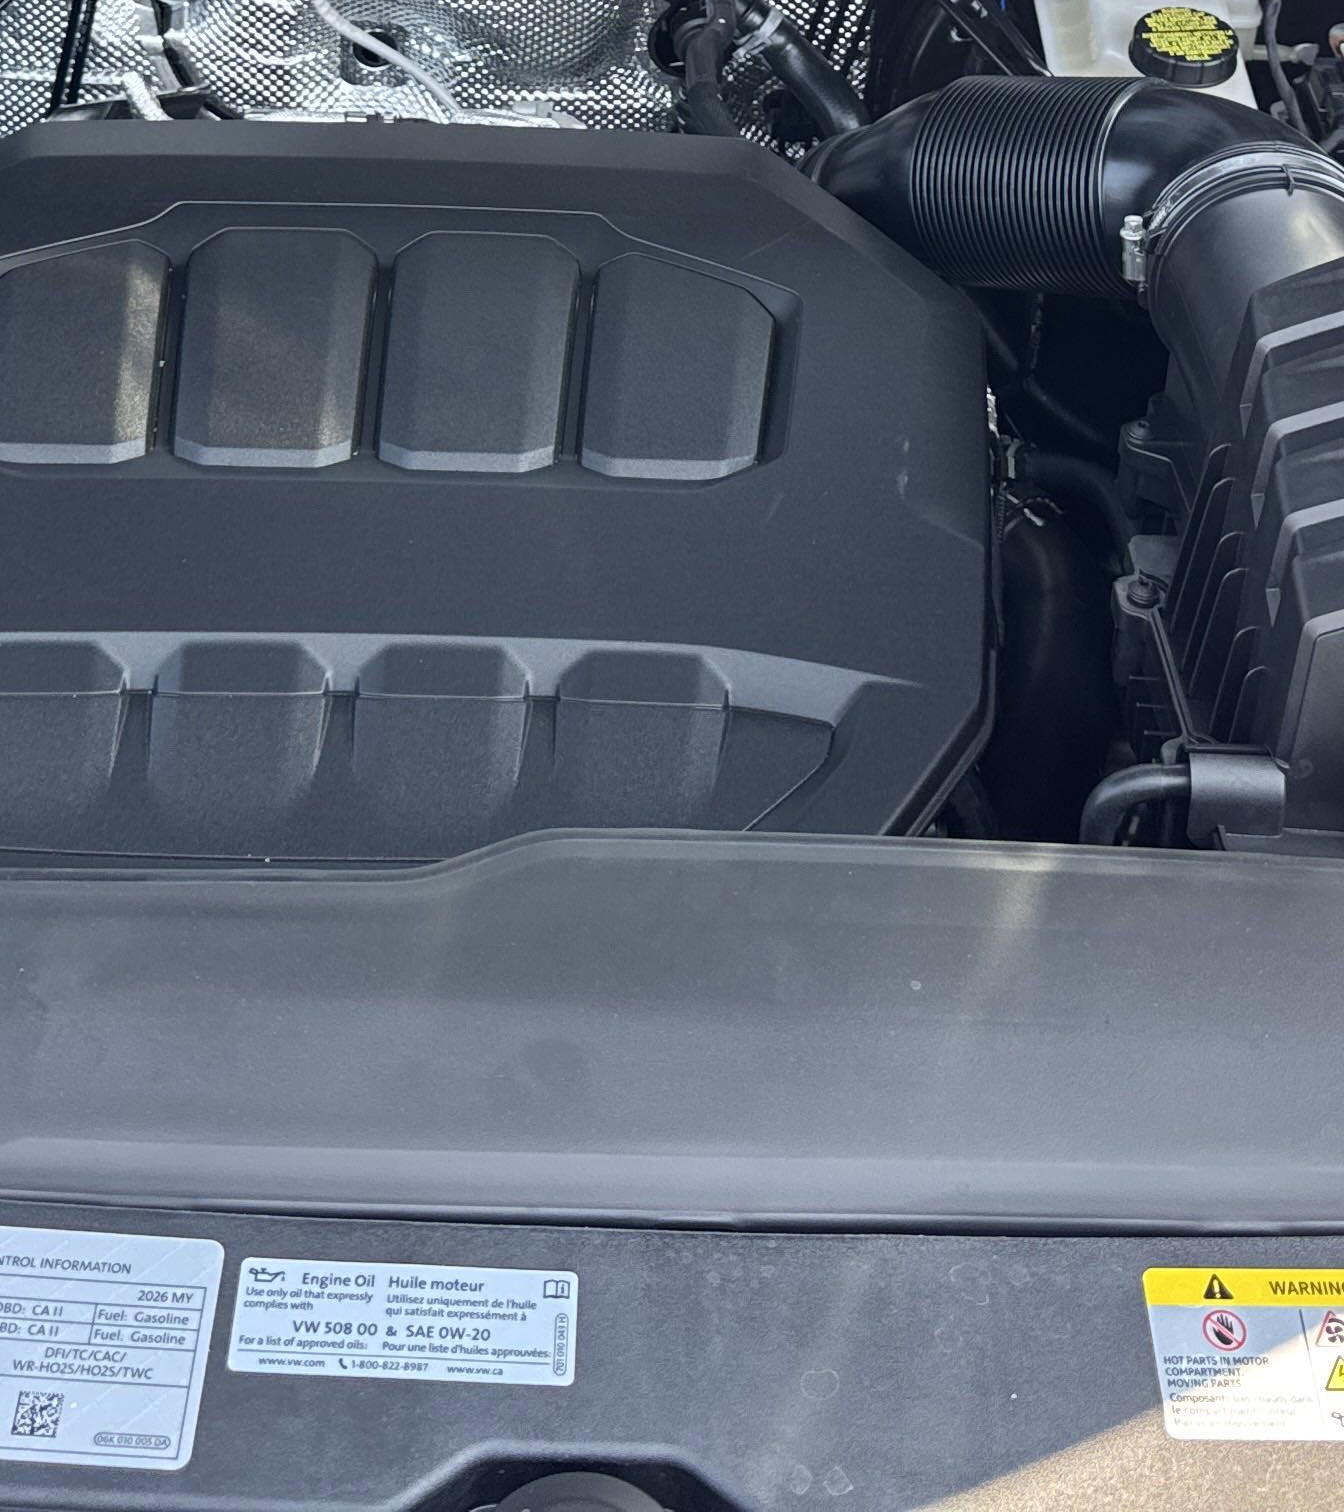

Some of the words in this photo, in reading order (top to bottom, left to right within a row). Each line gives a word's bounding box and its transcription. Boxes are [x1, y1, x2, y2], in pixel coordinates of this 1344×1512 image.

[40, 1258, 132, 1274] INFORMATION
[302, 1273, 351, 1289] Engine
[354, 1275, 375, 1287] Oil
[388, 1276, 427, 1289] Huile
[430, 1278, 485, 1291] moteur
[137, 1290, 169, 1302] 2026
[171, 1292, 194, 1304] MY
[246, 1287, 264, 1296] Use
[266, 1288, 288, 1299] only
[289, 1289, 303, 1298] oil
[304, 1290, 325, 1299] that
[327, 1291, 373, 1303] expressly
[387, 1294, 424, 1304] Utilisez
[427, 1296, 489, 1308] uniquement
[491, 1299, 504, 1308] de
[506, 1300, 537, 1310] l'huile
[31, 1304, 50, 1315] CA
[244, 1299, 288, 1311] complies
[290, 1301, 314, 1310] with
[97, 1309, 128, 1322] Fuel:
[134, 1310, 190, 1325] Gasoline
[385, 1307, 402, 1317] qui
[404, 1307, 444, 1317] satisfait
[447, 1309, 518, 1321] expressément
[520, 1311, 527, 1321] à
[27, 1324, 45, 1335] CA
[293, 1320, 320, 1333] VW
[324, 1322, 353, 1335] 508
[357, 1323, 378, 1336] 00
[386, 1326, 397, 1336] &
[406, 1325, 434, 1338] SAE
[439, 1327, 491, 1341] 0W-20
[130, 1331, 186, 1345] Gasoline
[238, 1335, 255, 1345] For
[266, 1336, 281, 1346] list
[284, 1337, 295, 1346] of
[297, 1338, 344, 1350] approved
[347, 1340, 368, 1349] oils:
[44, 1346, 127, 1363] DFI/TC/CAC/
[382, 1341, 405, 1351] Pour
[408, 1344, 426, 1352] une
[428, 1343, 448, 1353] liste
[451, 1345, 489, 1355] d'huiles
[491, 1347, 551, 1359] approuvées:
[258, 1357, 325, 1367] www.vw.com
[351, 1361, 428, 1372] 1-800-822-8987
[1163, 1355, 1184, 1365] HOT
[1186, 1356, 1218, 1366] PARTS
[1220, 1357, 1231, 1366] IN
[1233, 1356, 1269, 1366] MOTOR
[12, 1359, 155, 1380] WR-HO2S/HO2S/TWC
[447, 1366, 503, 1376] www.vw.ca
[1167, 1378, 1209, 1388] MOVING
[1210, 1379, 1241, 1388] PARTS
